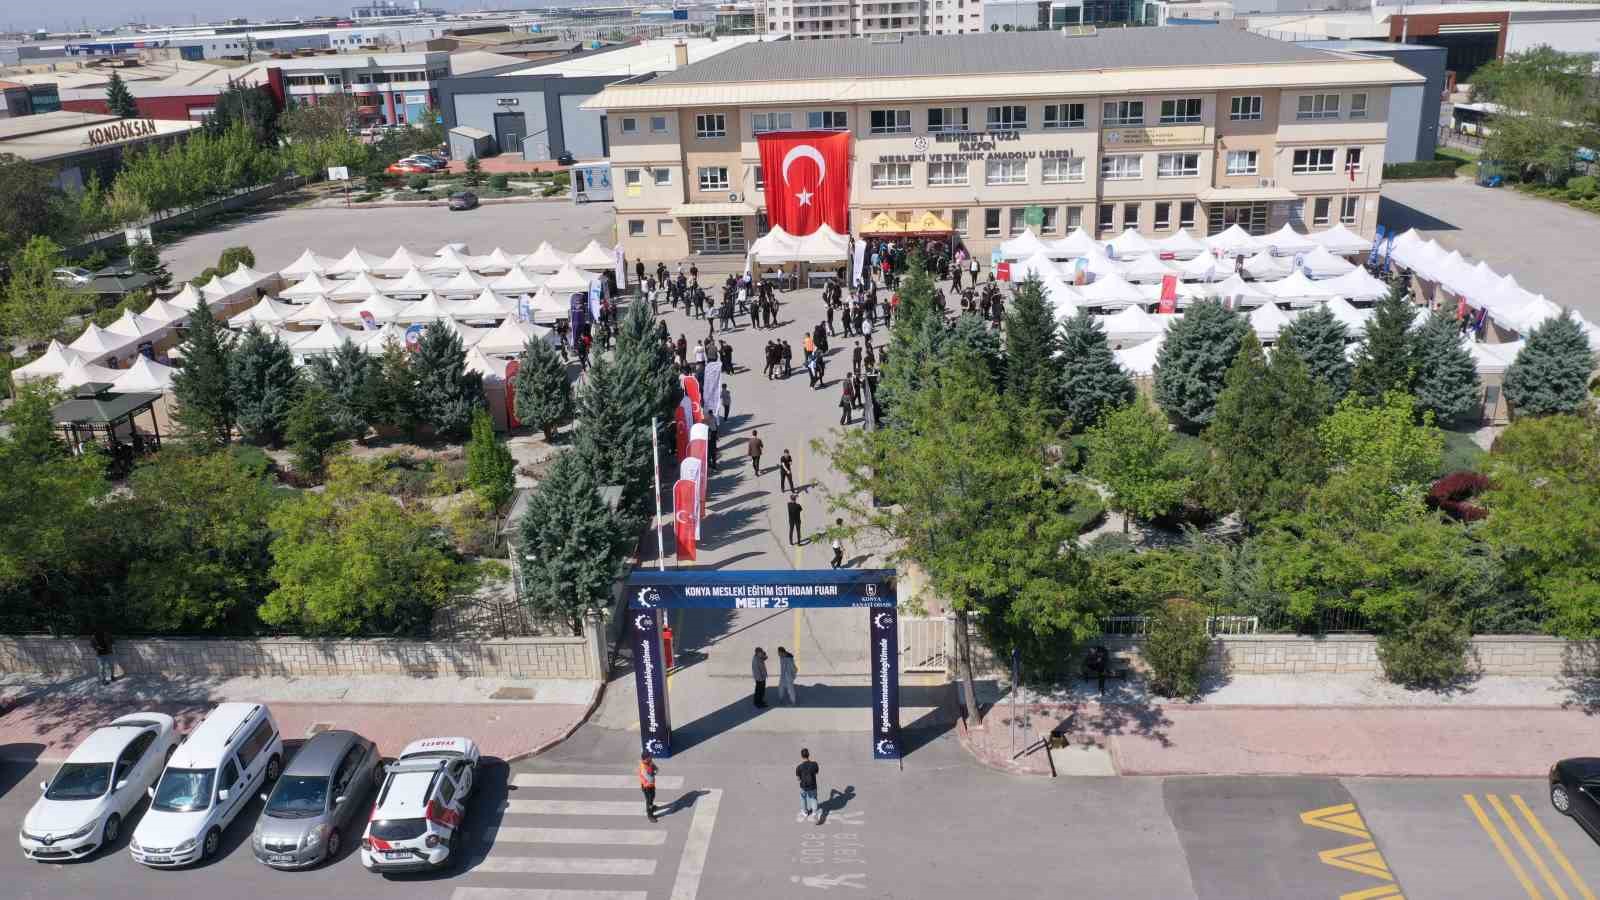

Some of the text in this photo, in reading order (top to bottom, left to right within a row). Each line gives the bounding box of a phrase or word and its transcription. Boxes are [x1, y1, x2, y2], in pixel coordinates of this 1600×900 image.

[88, 119, 157, 146] KONDÖKSAN
[929, 153, 943, 162] VE
[944, 152, 985, 161] TEKNİK
[987, 151, 1035, 160] ANADOLU
[685, 584, 838, 597] KONYA MESLEKİ EĞİTİM İSTİHDAM FUARI
[792, 832, 825, 864] önce
[832, 832, 865, 864] yaya
